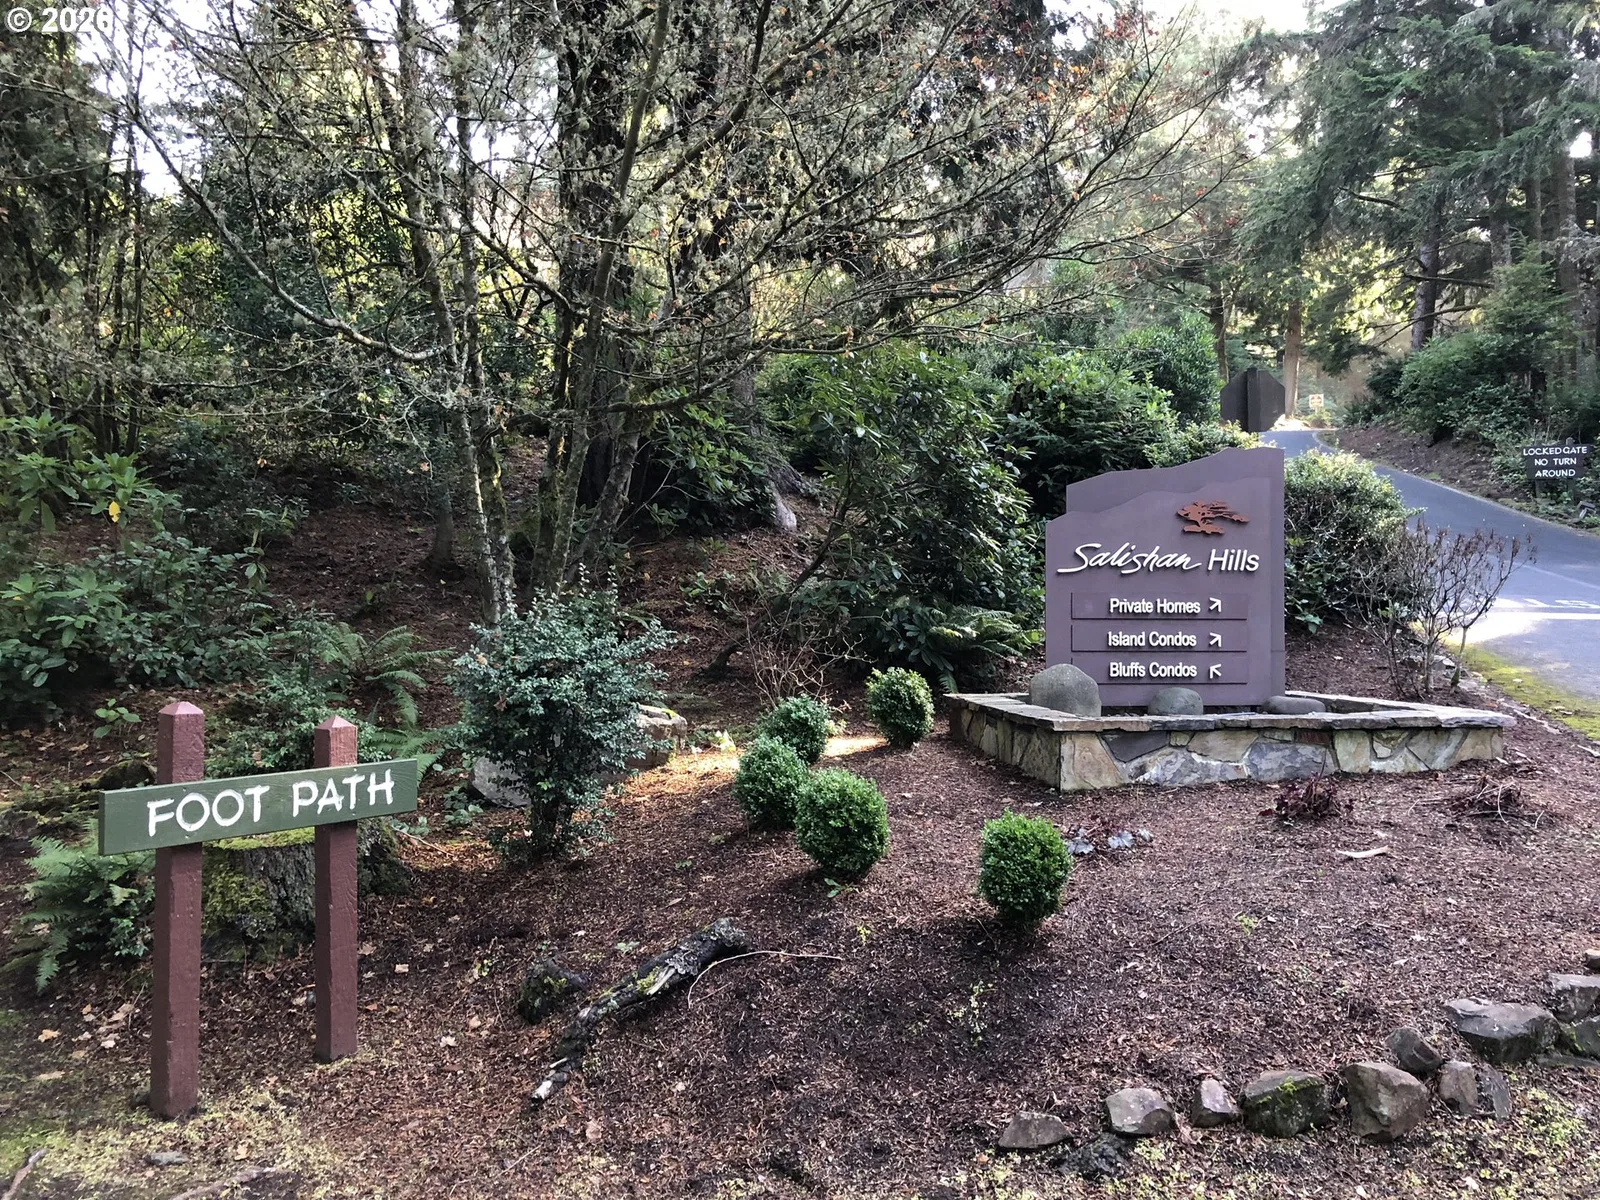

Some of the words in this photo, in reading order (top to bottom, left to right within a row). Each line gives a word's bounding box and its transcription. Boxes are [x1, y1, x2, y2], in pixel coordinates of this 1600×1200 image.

[1534, 458, 1548, 466] NO
[1553, 457, 1577, 465] TURN
[1535, 469, 1576, 477] AROUND
[1056, 542, 1202, 575] Salishan
[1207, 549, 1260, 572] Hills
[1109, 598, 1154, 614] Private
[1156, 598, 1201, 614] Homes
[1108, 631, 1146, 647] Island
[1149, 631, 1197, 647] Condos
[1109, 662, 1146, 678] Bluffs
[1149, 662, 1198, 678] Condos
[147, 784, 270, 837] FOOT
[292, 768, 395, 818] PATH
